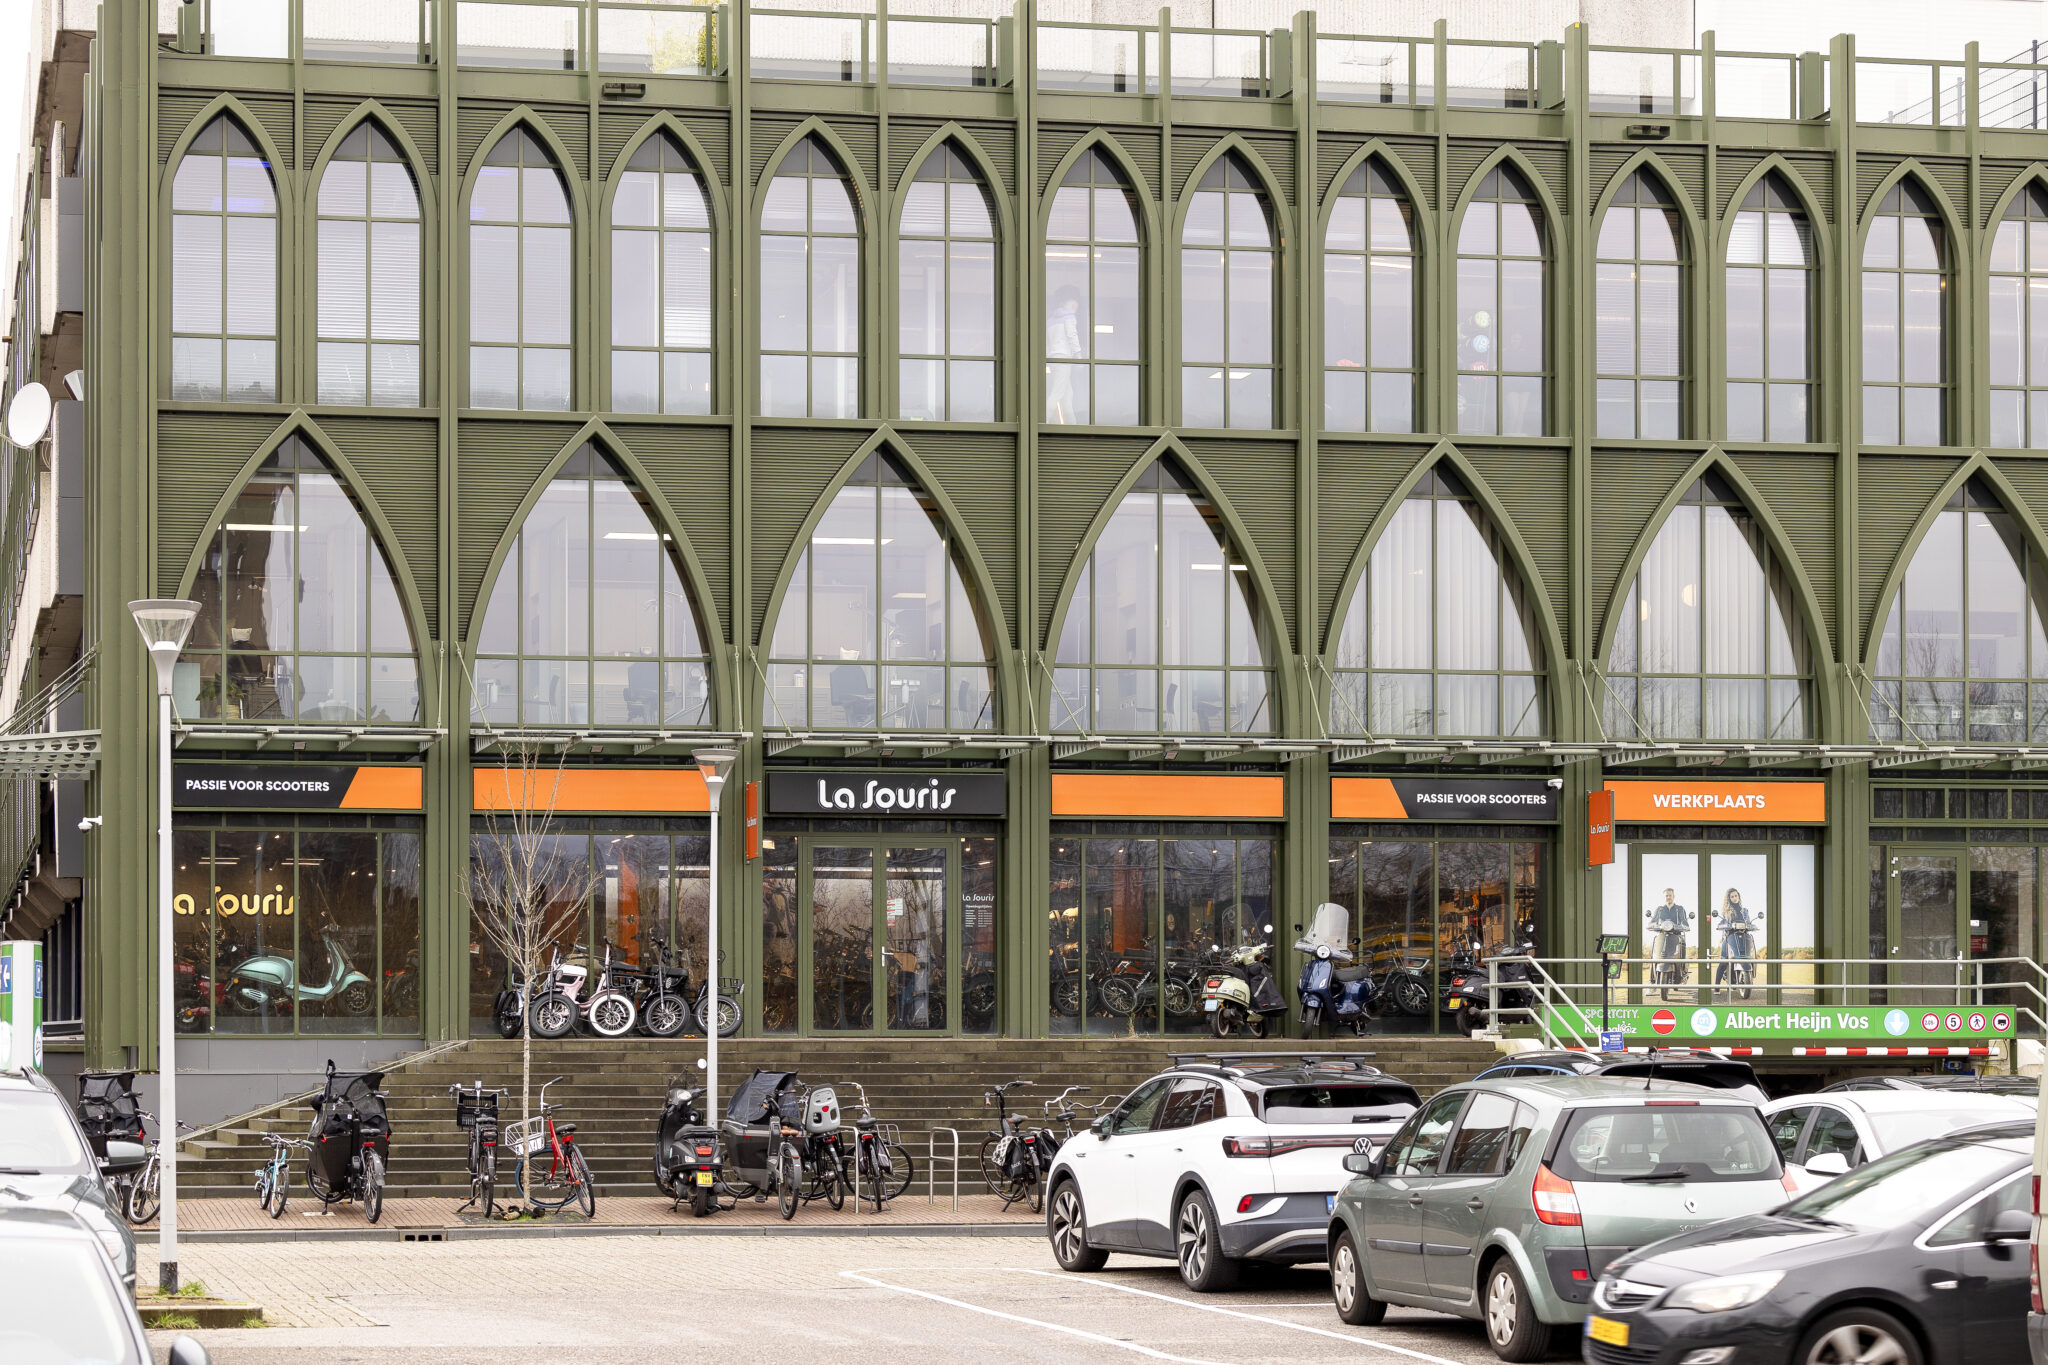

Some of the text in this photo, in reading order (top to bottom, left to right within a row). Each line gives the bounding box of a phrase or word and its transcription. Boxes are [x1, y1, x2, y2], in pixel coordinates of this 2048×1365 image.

[186, 779, 330, 792] PASSIE VOOR SCOOTERS
[817, 778, 957, 810] La Souris
[1416, 793, 1547, 805] PASSIE VOOR SCOOTERS
[1652, 794, 1766, 809] WERKPLAATS
[173, 893, 195, 915] a
[962, 893, 995, 902] La Souris
[1725, 1012, 1869, 1032] Albert Heijn Vos
[1950, 1017, 1957, 1028] 5
